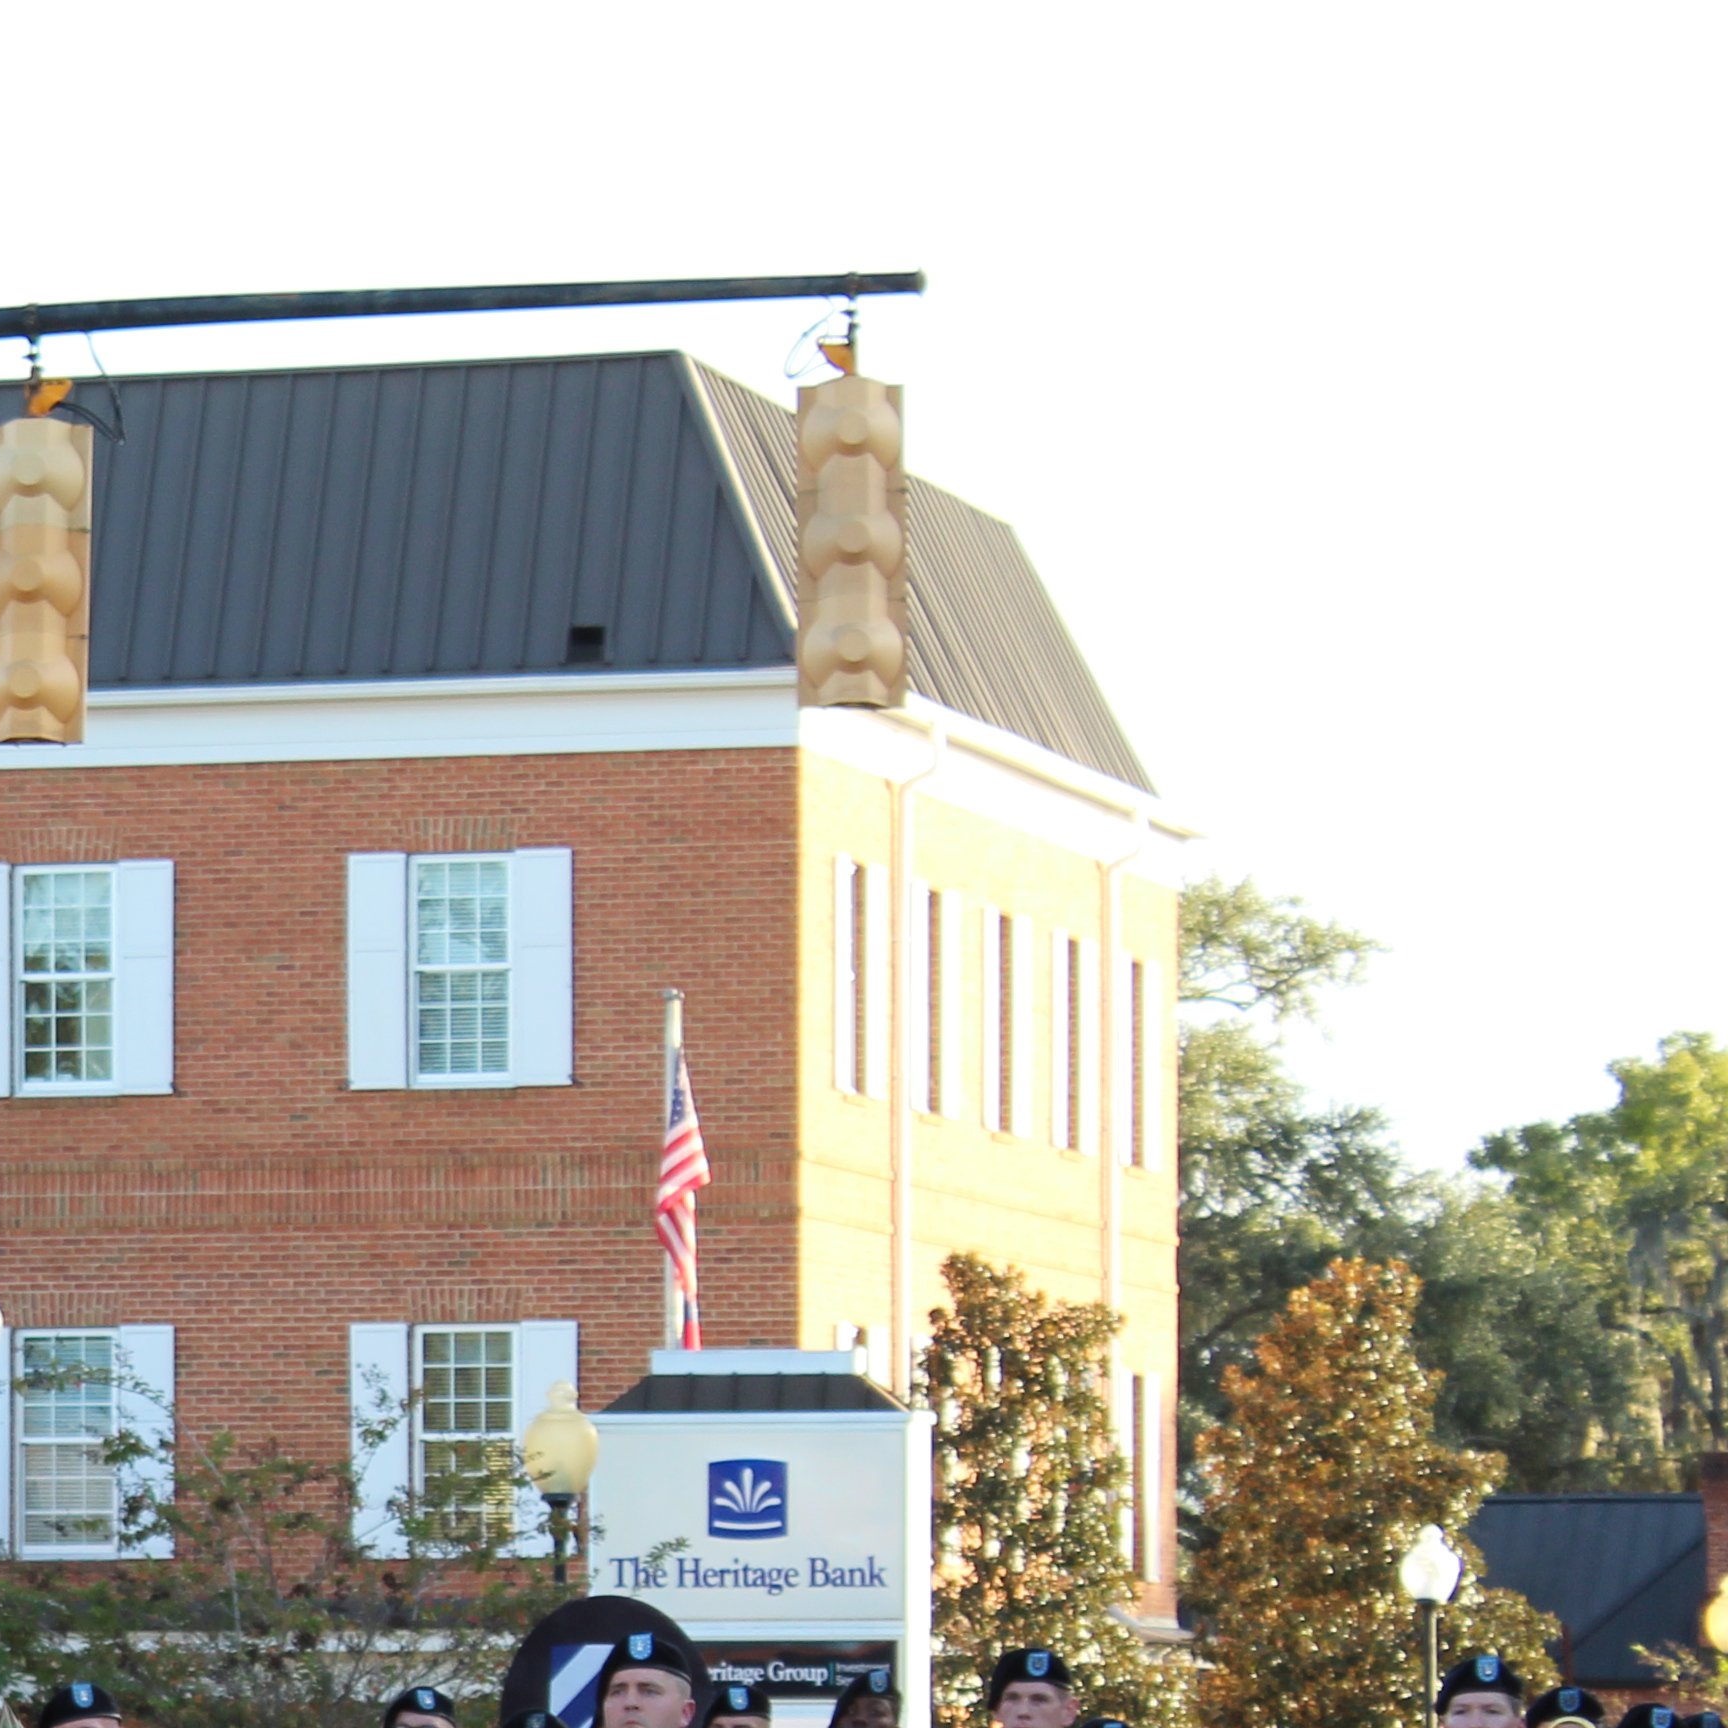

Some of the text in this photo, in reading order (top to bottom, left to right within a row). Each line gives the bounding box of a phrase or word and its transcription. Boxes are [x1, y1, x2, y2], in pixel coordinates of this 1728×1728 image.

[609, 1555, 888, 1596] The Heritage Bank
[767, 1661, 829, 1687] Group
